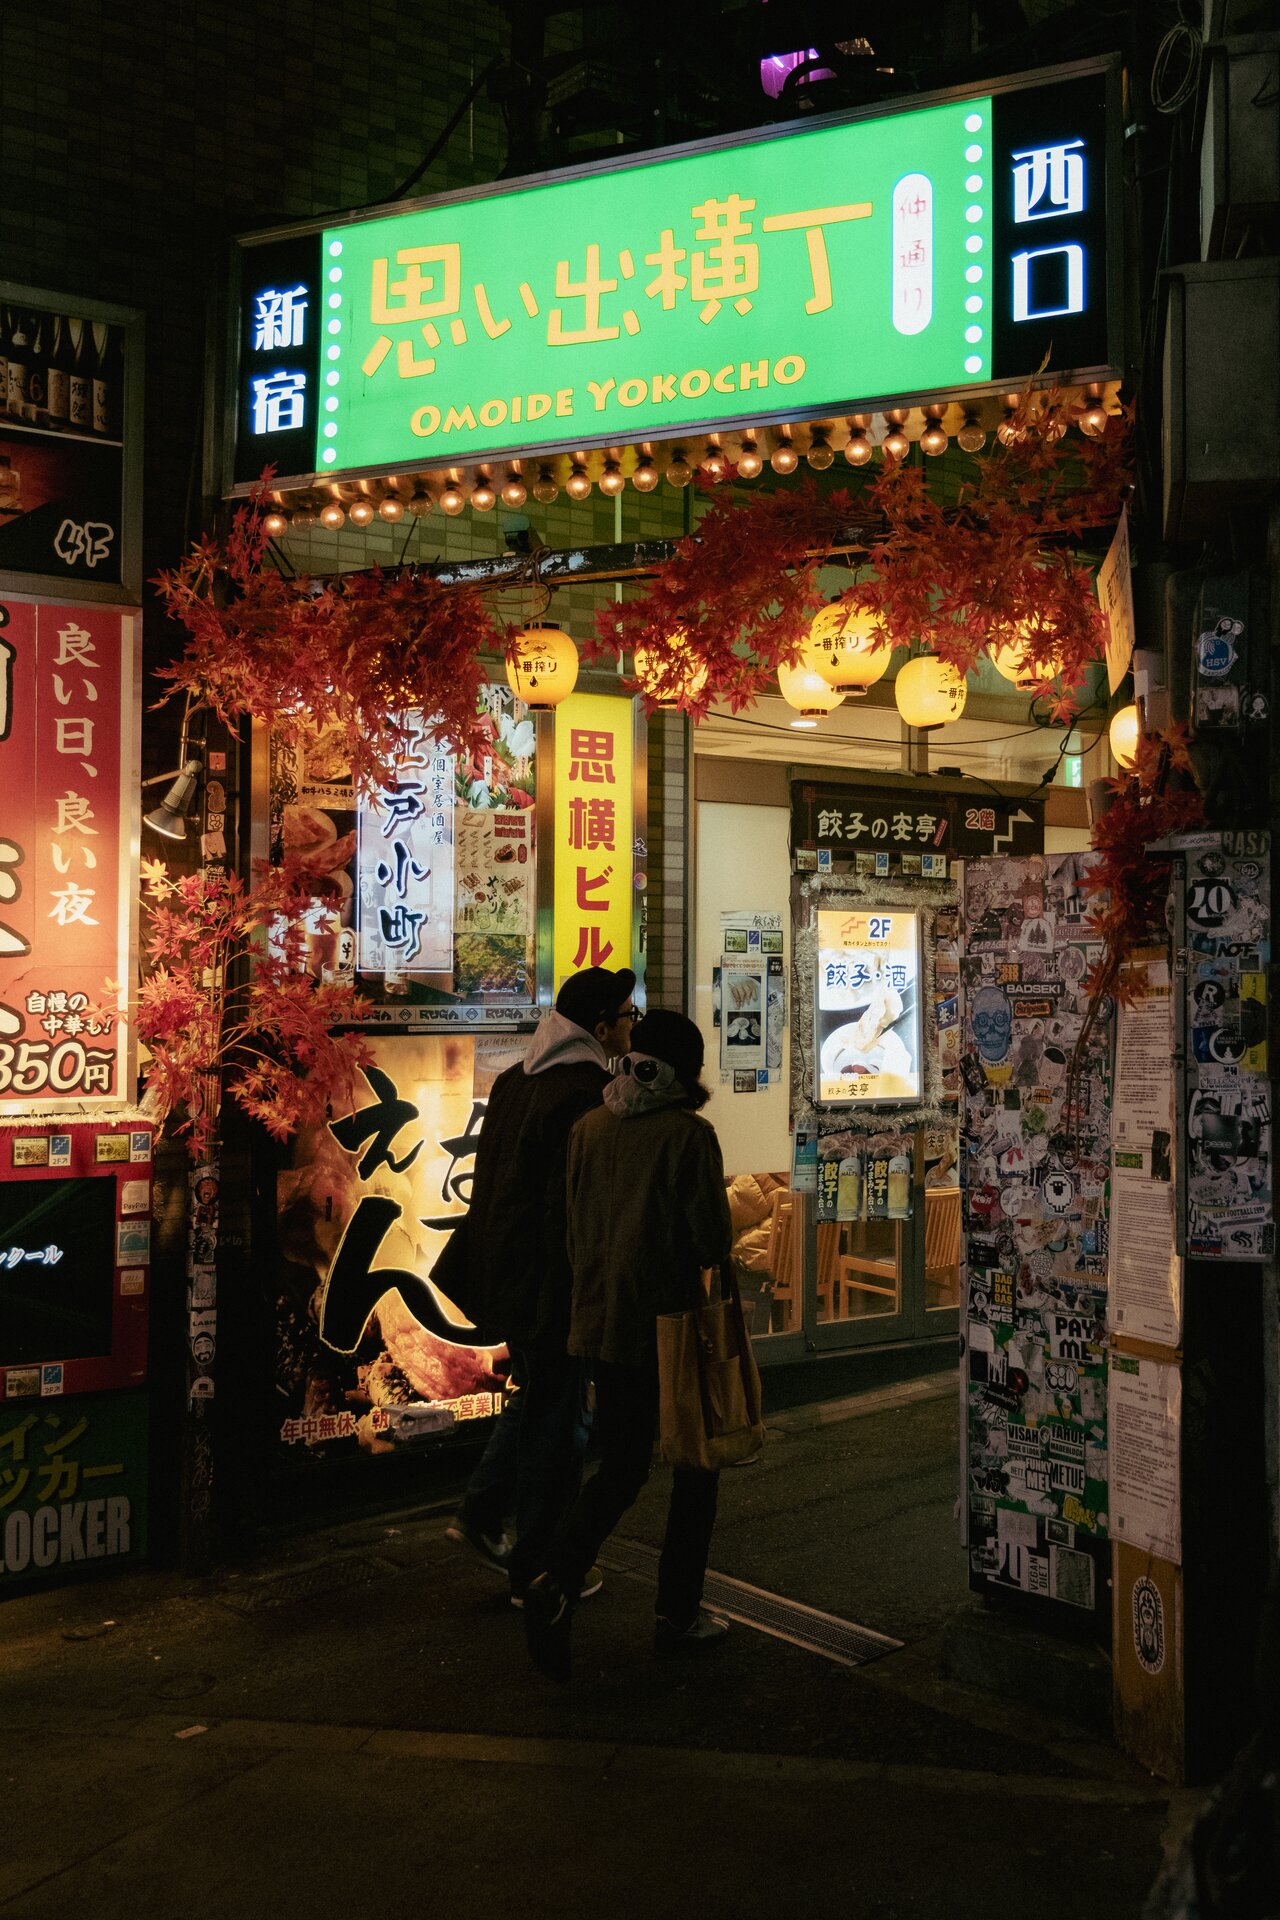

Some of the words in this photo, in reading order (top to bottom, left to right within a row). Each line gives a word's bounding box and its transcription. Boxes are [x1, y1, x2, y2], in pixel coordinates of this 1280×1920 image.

[1011, 140, 1087, 322] 西口
[898, 193, 927, 313] 仲通り
[361, 193, 873, 379] 思い出横丁
[253, 285, 308, 435] 新宿
[410, 387, 575, 438] OMOIDE
[587, 354, 807, 412] YOKOCHO
[814, 636, 860, 651] 一番搾り
[518, 660, 557, 673] 番搾り
[1206, 657, 1227, 667] HSV
[48, 622, 100, 926] 良い日、良い夜
[817, 808, 938, 843] 餃子の安亭
[965, 808, 995, 830] 2階
[568, 728, 616, 968] 思横ビル
[935, 858, 944, 867] 2F
[869, 918, 891, 938] 2F
[825, 962, 907, 988] 餃子・酒
[1006, 984, 1061, 994] BADSEKI
[26, 991, 88, 1015] 自慢の
[485, 1006, 524, 1021] RUGA
[420, 1007, 460, 1021] RUGA
[123, 1201, 148, 1211] PayPay
[994, 1273, 1013, 1284] DAG
[994, 1283, 1013, 1295] DAL
[994, 1294, 1013, 1306] GAS
[1056, 1316, 1093, 1339] PAY
[1008, 1424, 1040, 1444] VISAH
[1026, 1457, 1052, 1471] FUNKY
[1030, 1556, 1039, 1592] VEGAN
[1038, 1564, 1048, 1588] DIET
